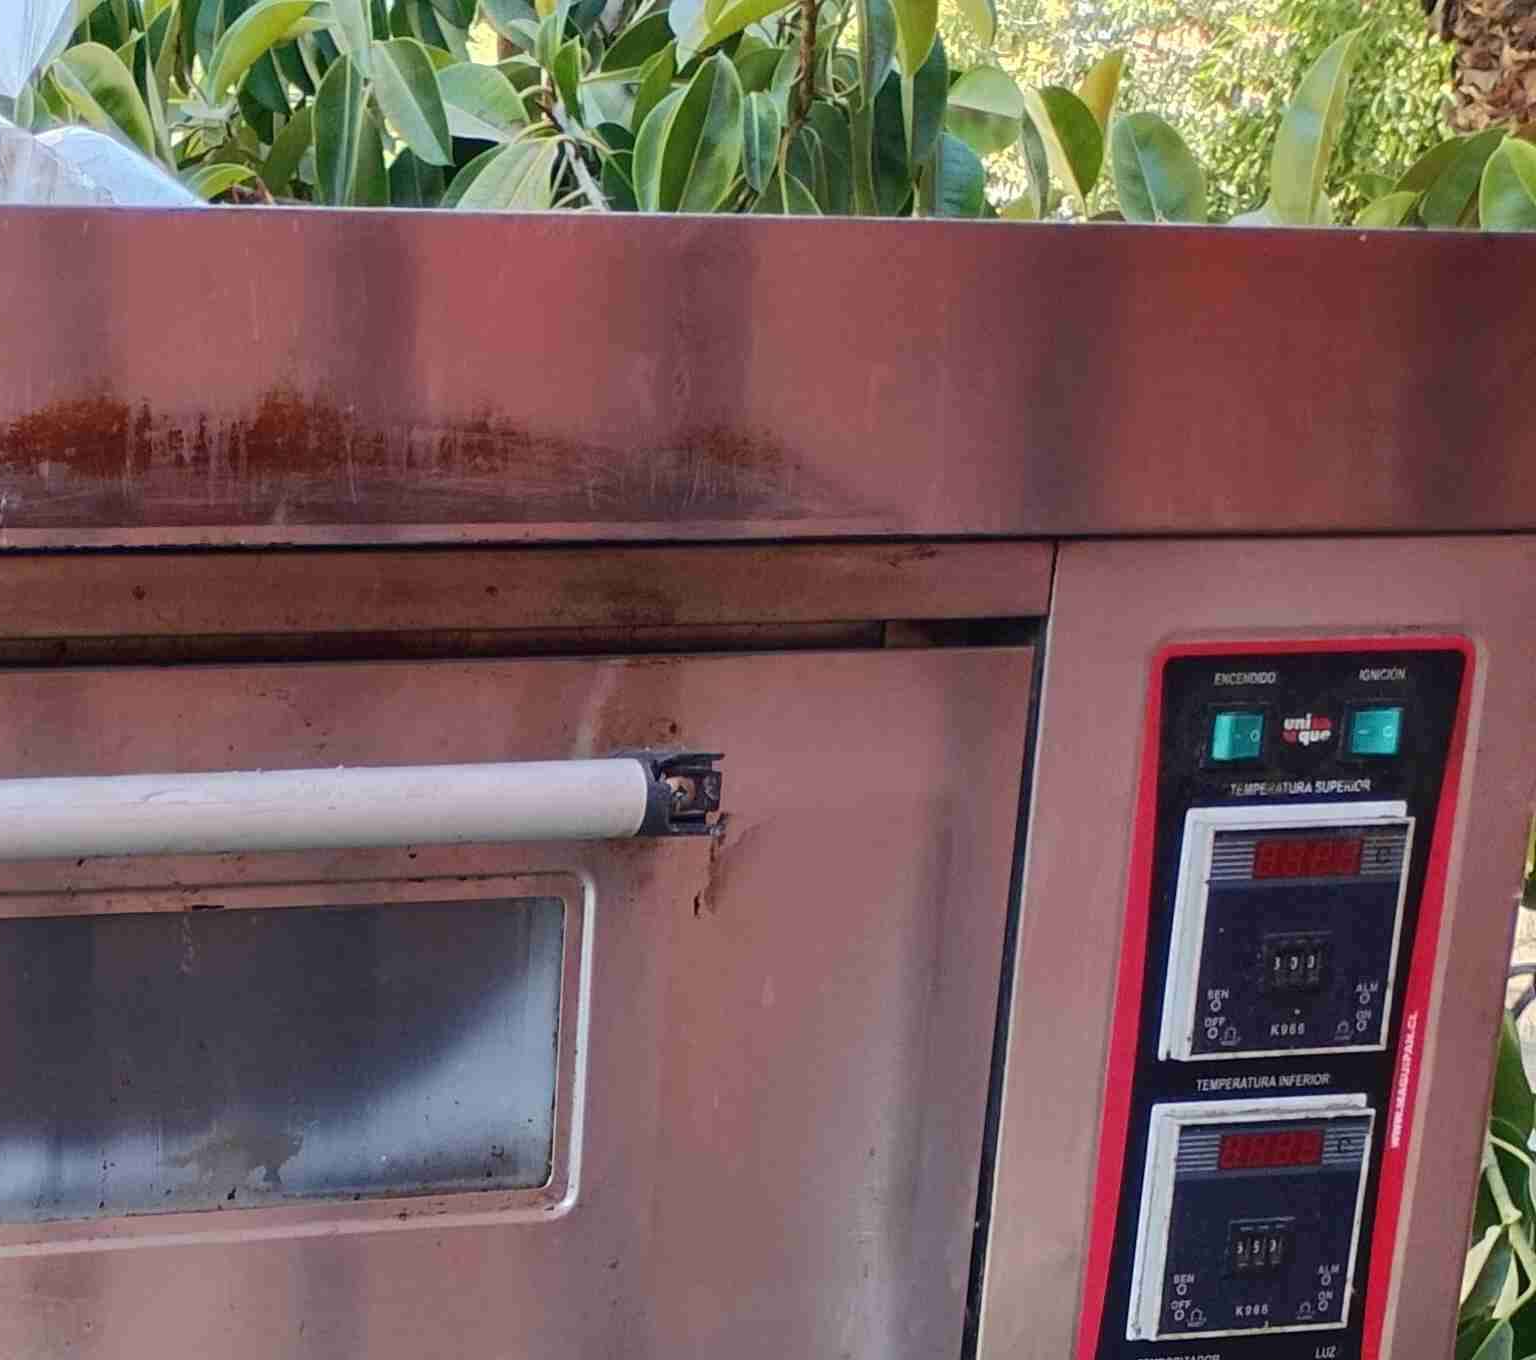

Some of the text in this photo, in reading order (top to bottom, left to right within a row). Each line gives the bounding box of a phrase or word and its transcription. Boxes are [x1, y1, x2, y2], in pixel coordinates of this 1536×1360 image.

[1214, 671, 1277, 686] ENCENDIDO
[1359, 667, 1406, 682] IGNICIÓN
[1230, 778, 1372, 796] TEMPERATURA SUPERIOR
[1196, 1073, 1331, 1091] TEMPERATURA INFERIOR
[1315, 1346, 1337, 1360] LUZ
